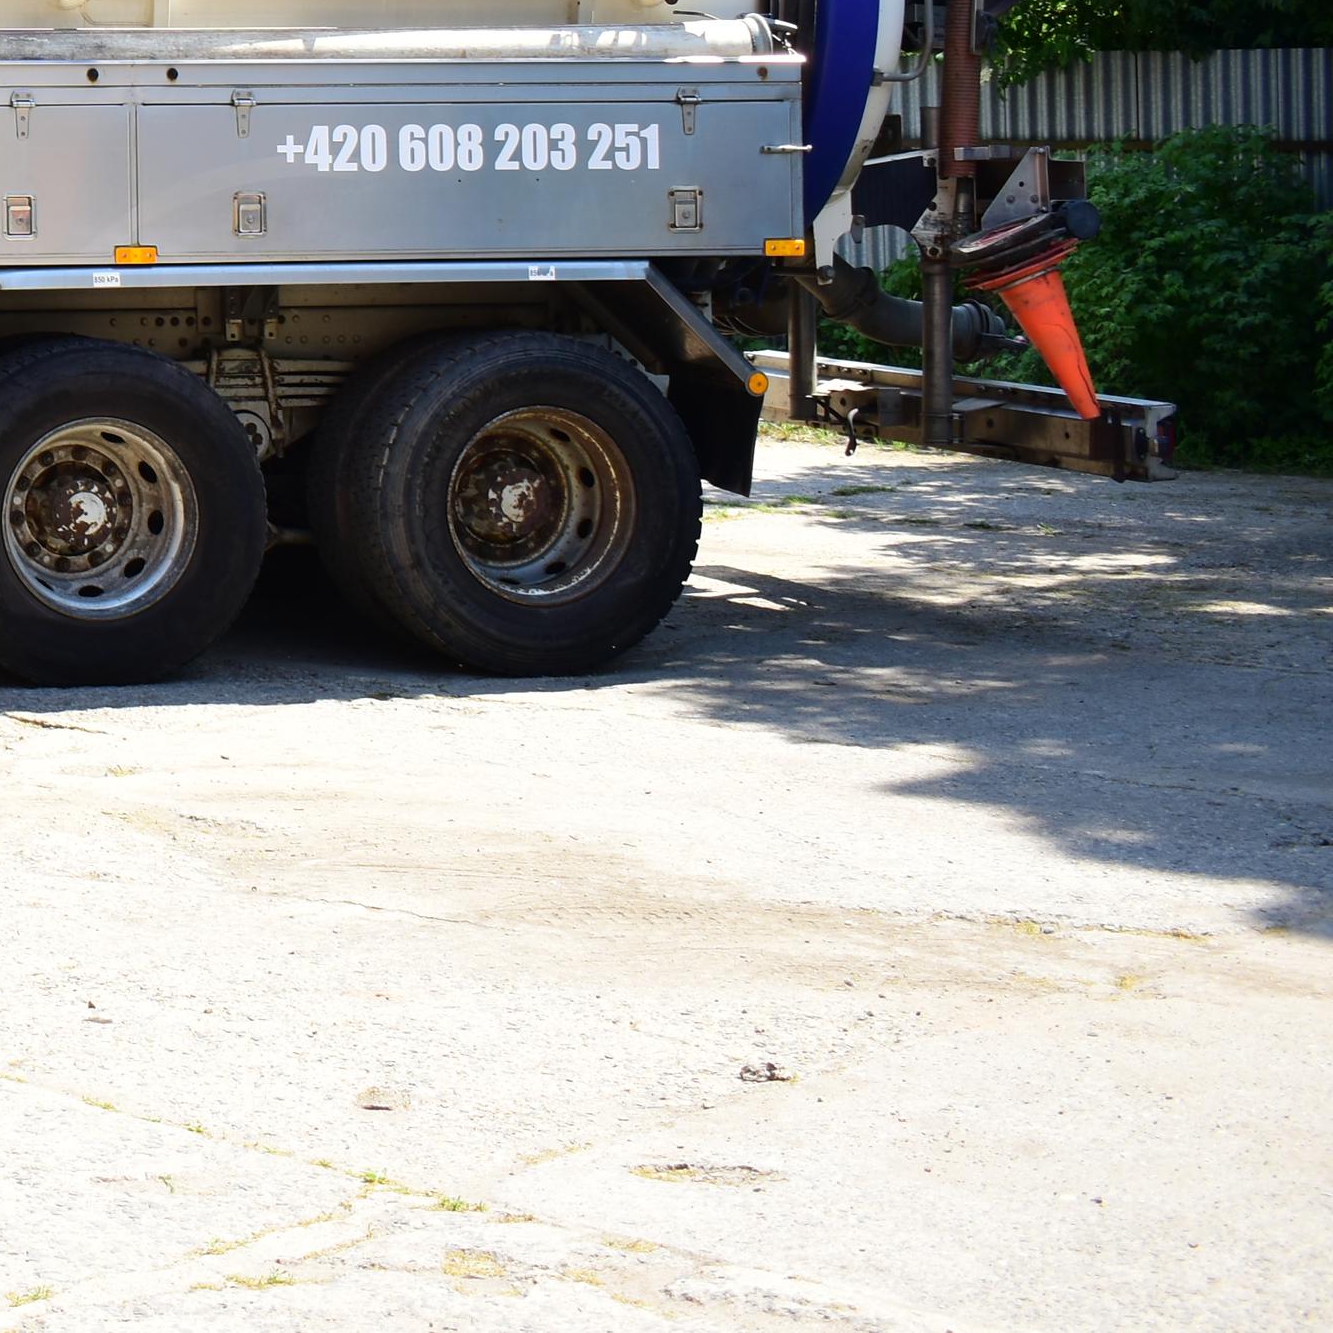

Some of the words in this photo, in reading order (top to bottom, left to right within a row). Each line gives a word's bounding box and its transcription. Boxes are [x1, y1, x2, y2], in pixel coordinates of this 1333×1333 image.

[276, 124, 388, 172] +420
[398, 123, 484, 172] 608
[494, 123, 577, 171] 203
[587, 122, 660, 170] 251
